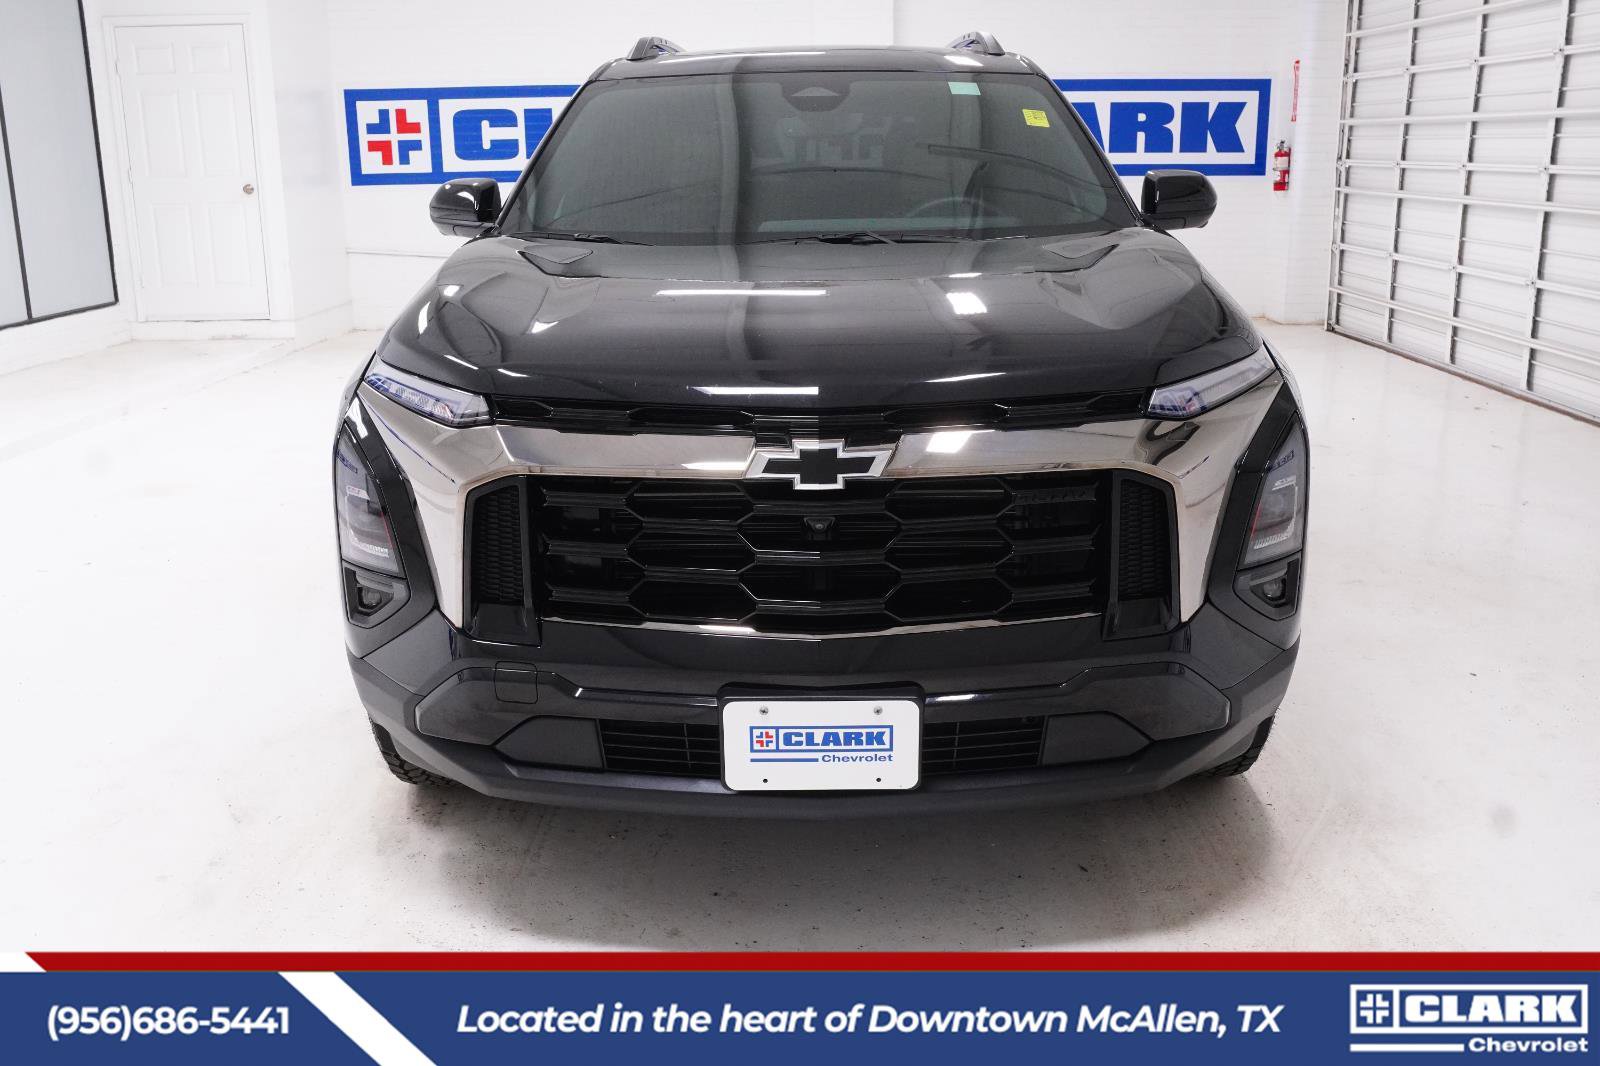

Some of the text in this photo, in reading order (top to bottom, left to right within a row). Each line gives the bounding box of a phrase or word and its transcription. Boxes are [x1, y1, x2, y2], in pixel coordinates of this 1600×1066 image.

[1070, 101, 1248, 154] RK
[782, 731, 886, 747] CLARK
[820, 752, 894, 764] Chevrolet
